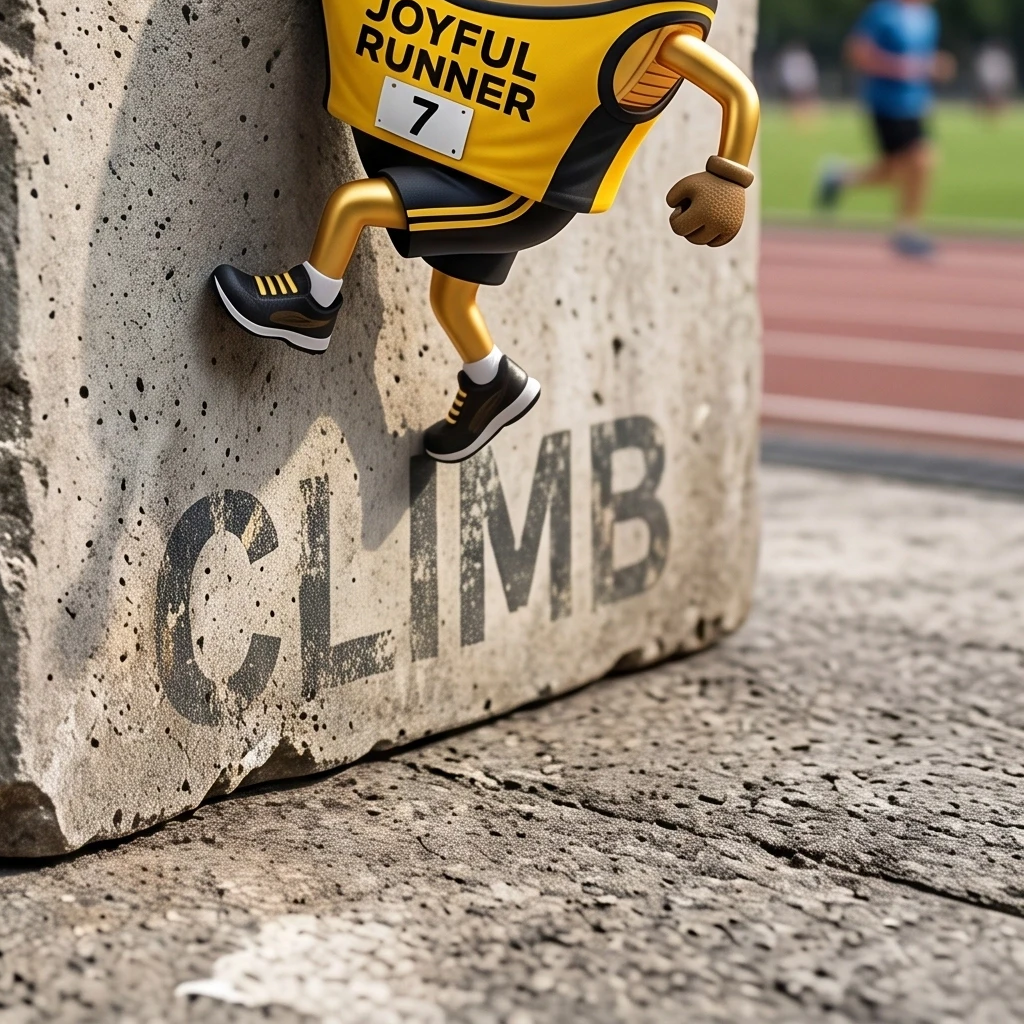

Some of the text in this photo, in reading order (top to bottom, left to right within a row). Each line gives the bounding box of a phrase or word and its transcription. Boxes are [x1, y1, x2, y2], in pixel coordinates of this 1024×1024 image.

[355, 23, 536, 123] RUNNER
[409, 95, 439, 136] 7
[156, 415, 671, 726] CLIMB
